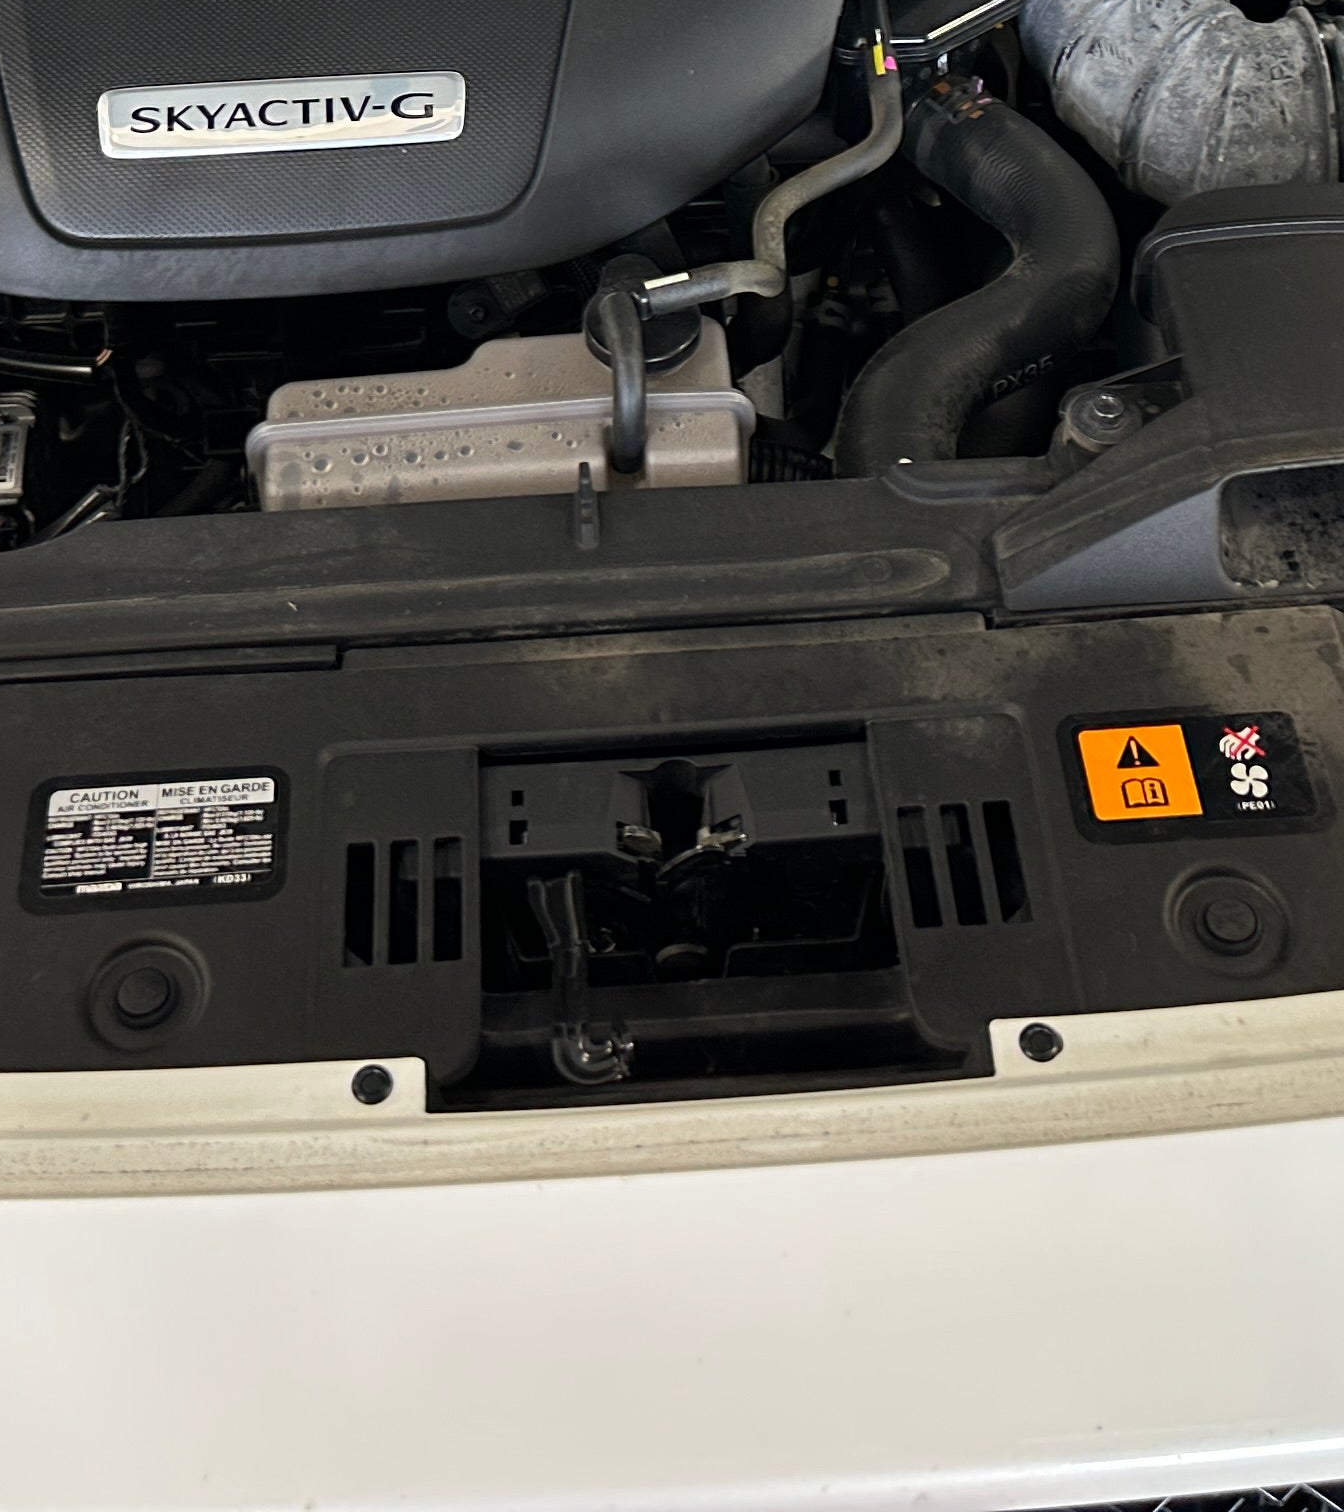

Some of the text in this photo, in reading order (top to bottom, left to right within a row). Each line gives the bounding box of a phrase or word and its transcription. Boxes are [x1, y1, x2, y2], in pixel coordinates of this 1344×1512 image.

[130, 92, 435, 134] SKYACTIV-G
[69, 789, 140, 804] CAUTION
[162, 782, 271, 798] MISE EN GARDE
[57, 800, 149, 813] AIR CONDITIONER
[180, 794, 249, 805] CLIMATISEUR
[213, 873, 252, 884] (KD33)
